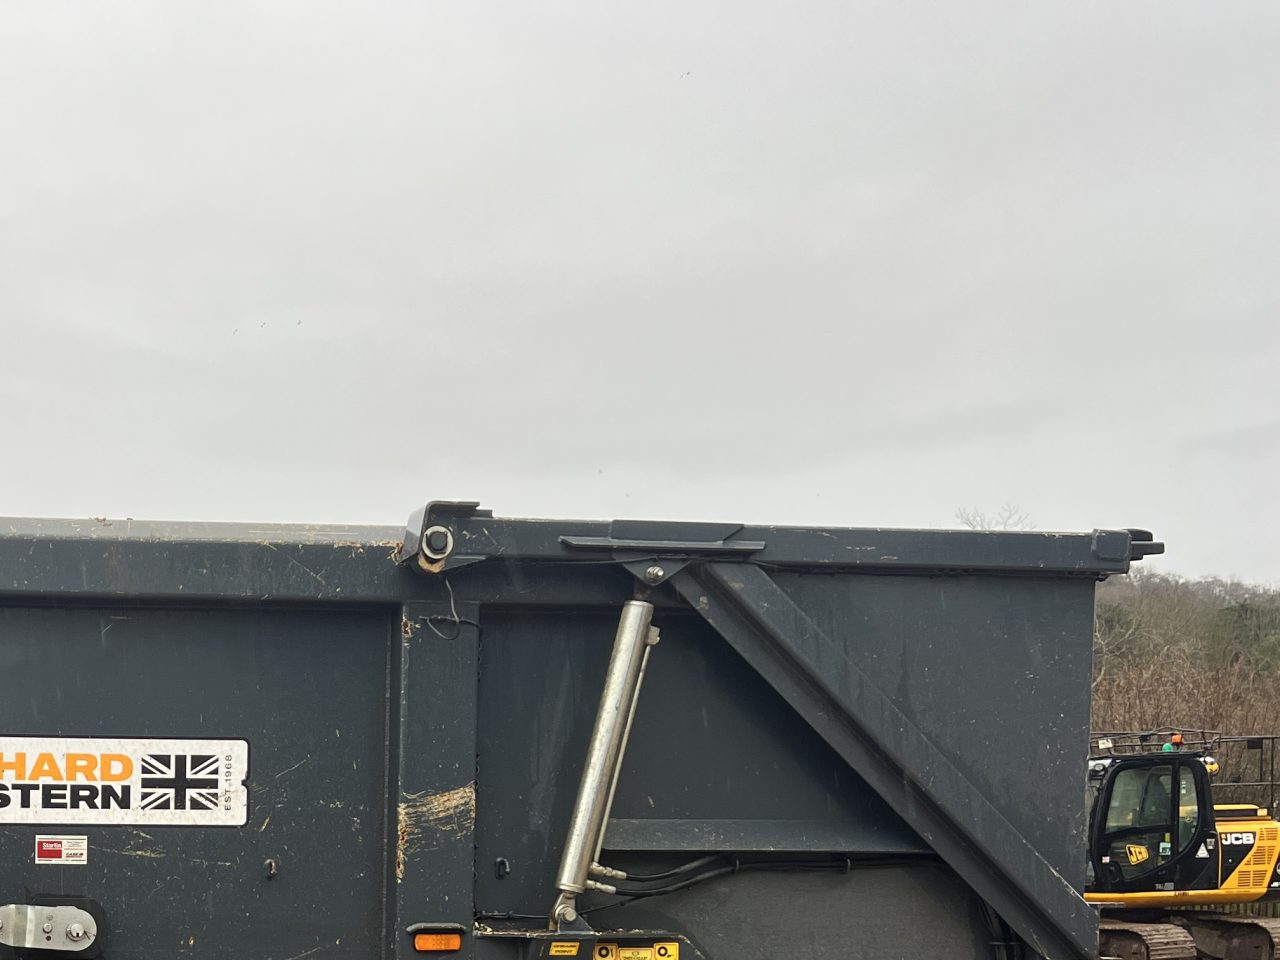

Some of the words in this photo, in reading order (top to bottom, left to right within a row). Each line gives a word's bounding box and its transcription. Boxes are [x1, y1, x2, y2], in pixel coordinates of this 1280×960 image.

[224, 754, 233, 782] 1968
[1221, 832, 1255, 845] JCB
[1128, 846, 1148, 863] JCB
